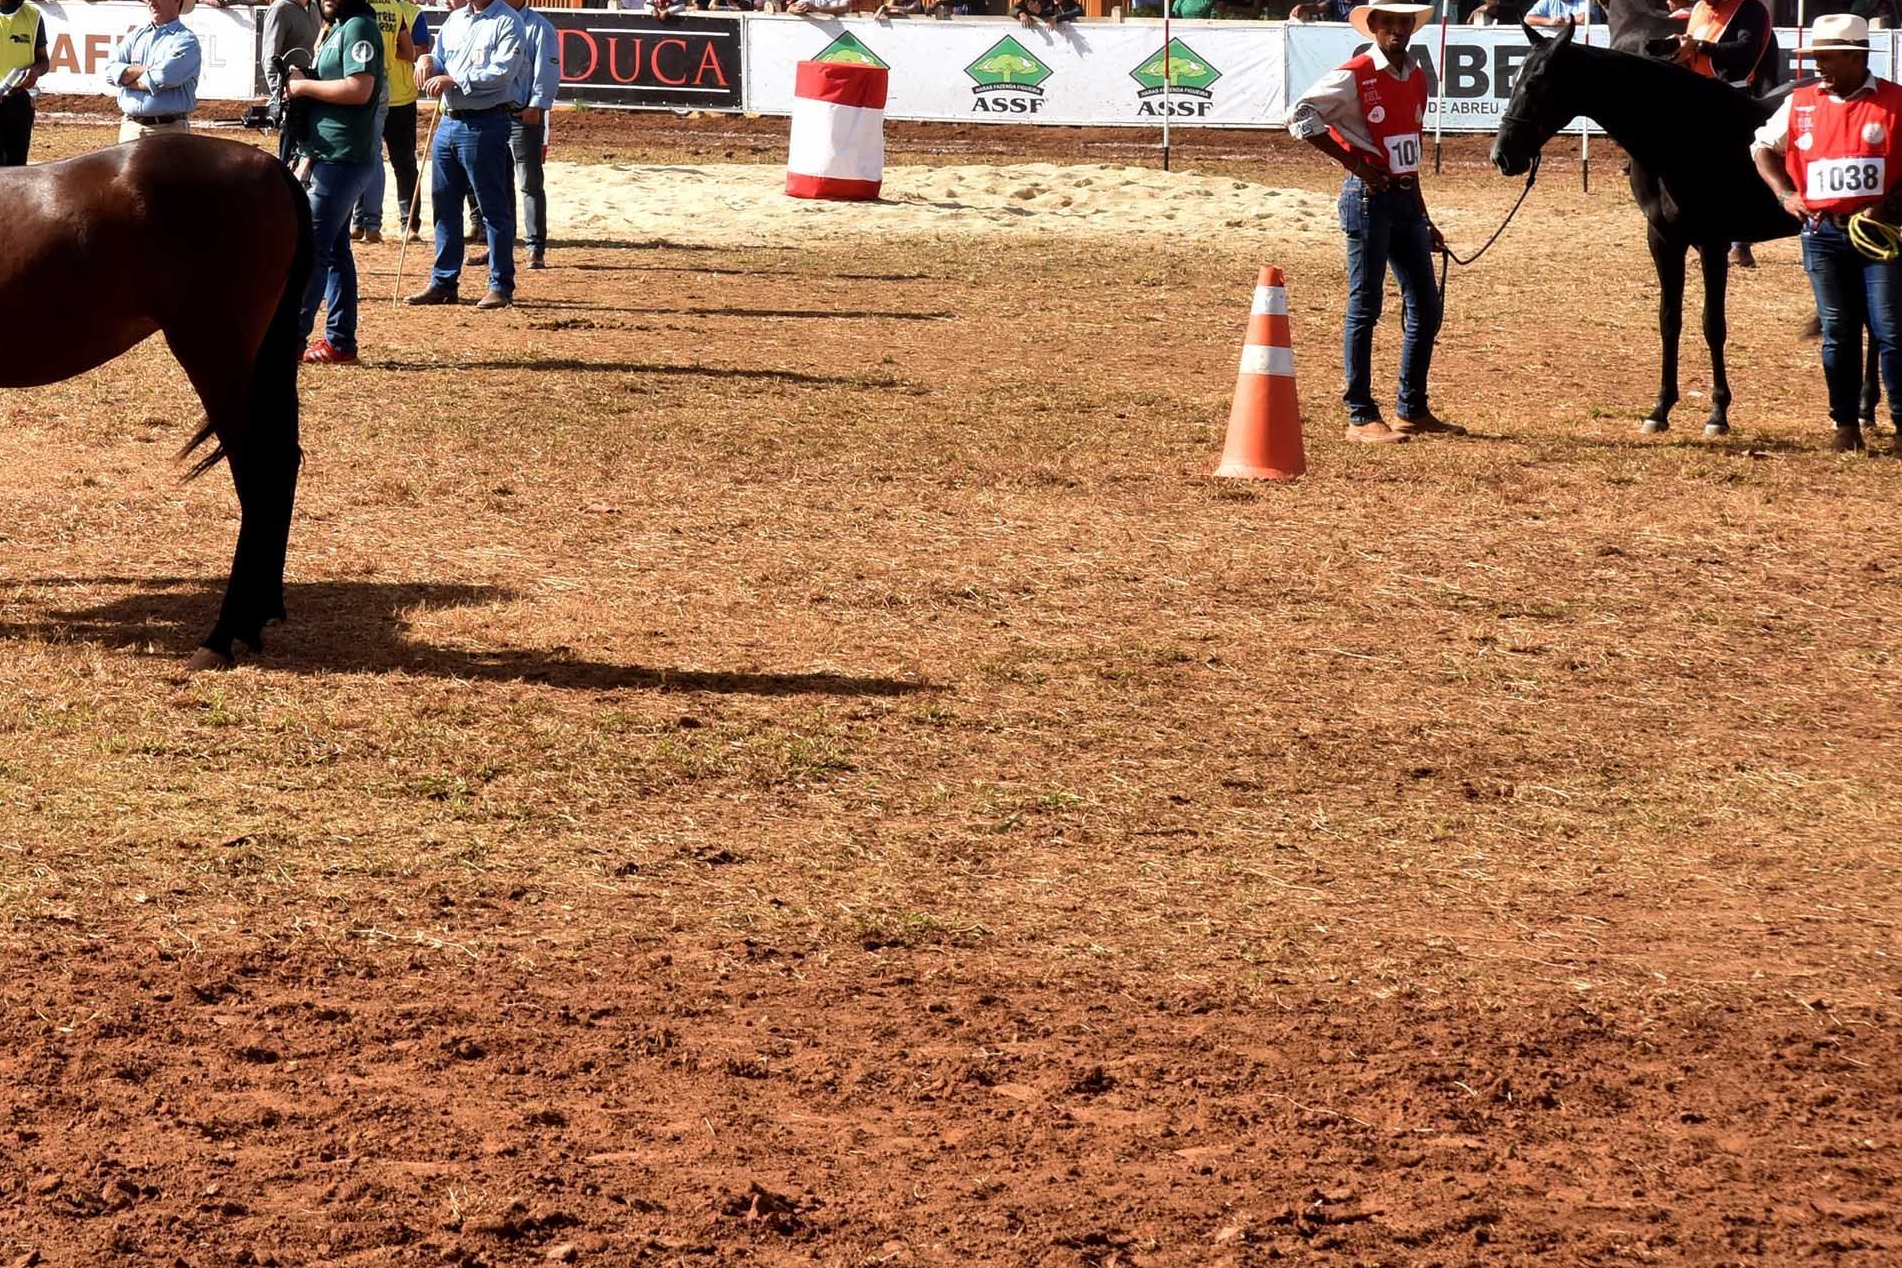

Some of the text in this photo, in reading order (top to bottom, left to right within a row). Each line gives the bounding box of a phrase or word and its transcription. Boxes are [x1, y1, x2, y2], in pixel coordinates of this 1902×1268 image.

[49, 28, 136, 74] AF
[556, 28, 729, 85] DUCA
[971, 97, 1045, 113] ASSF
[1137, 101, 1213, 116] ASSF
[1450, 102, 1498, 114] ABREU
[1392, 139, 1418, 166] 10
[1816, 164, 1879, 192] 1038
